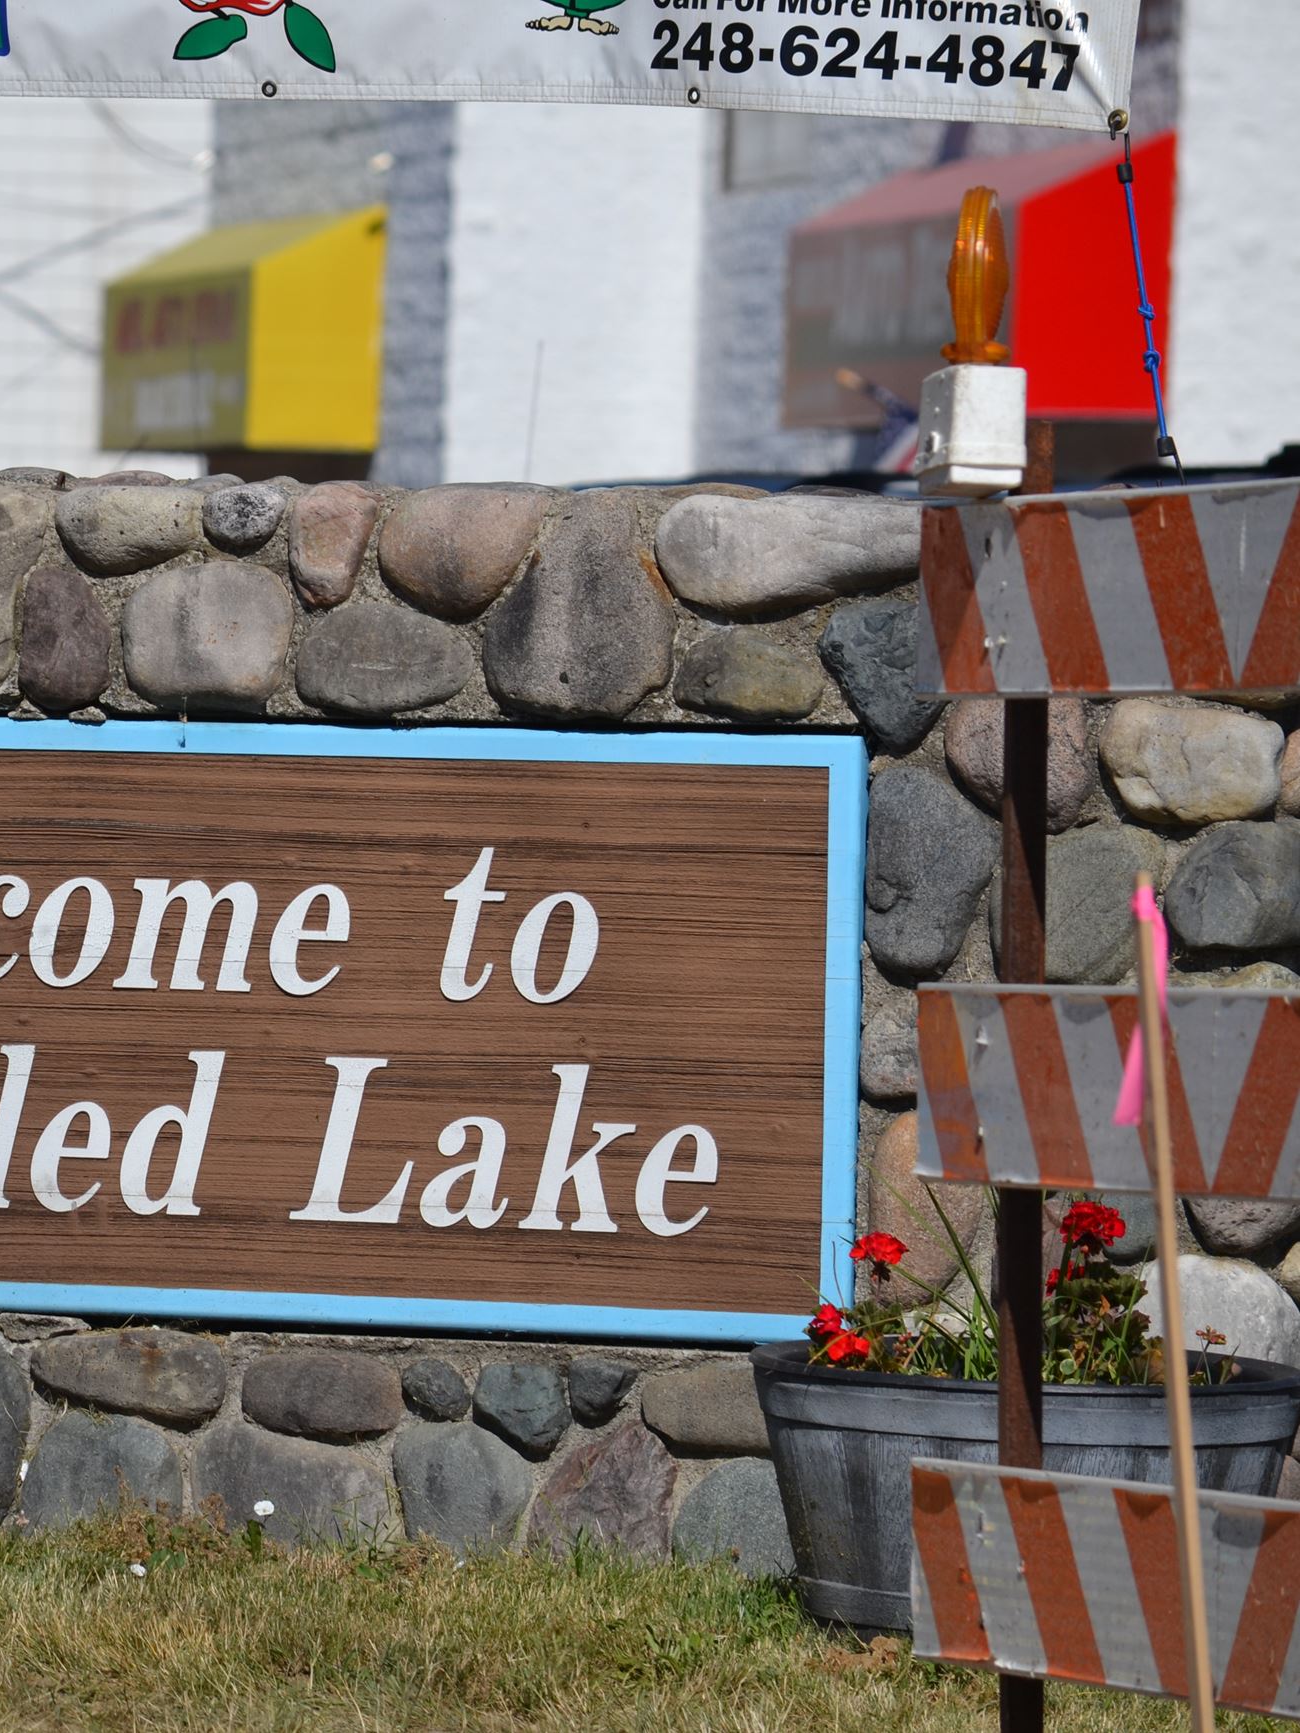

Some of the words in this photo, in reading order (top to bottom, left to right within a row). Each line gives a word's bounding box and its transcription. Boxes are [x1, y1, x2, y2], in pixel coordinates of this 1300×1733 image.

[650, 19, 1081, 92] 248-624-4847
[880, 0, 1090, 33] Information
[439, 846, 600, 1004] to
[288, 1056, 719, 1237] Lake
